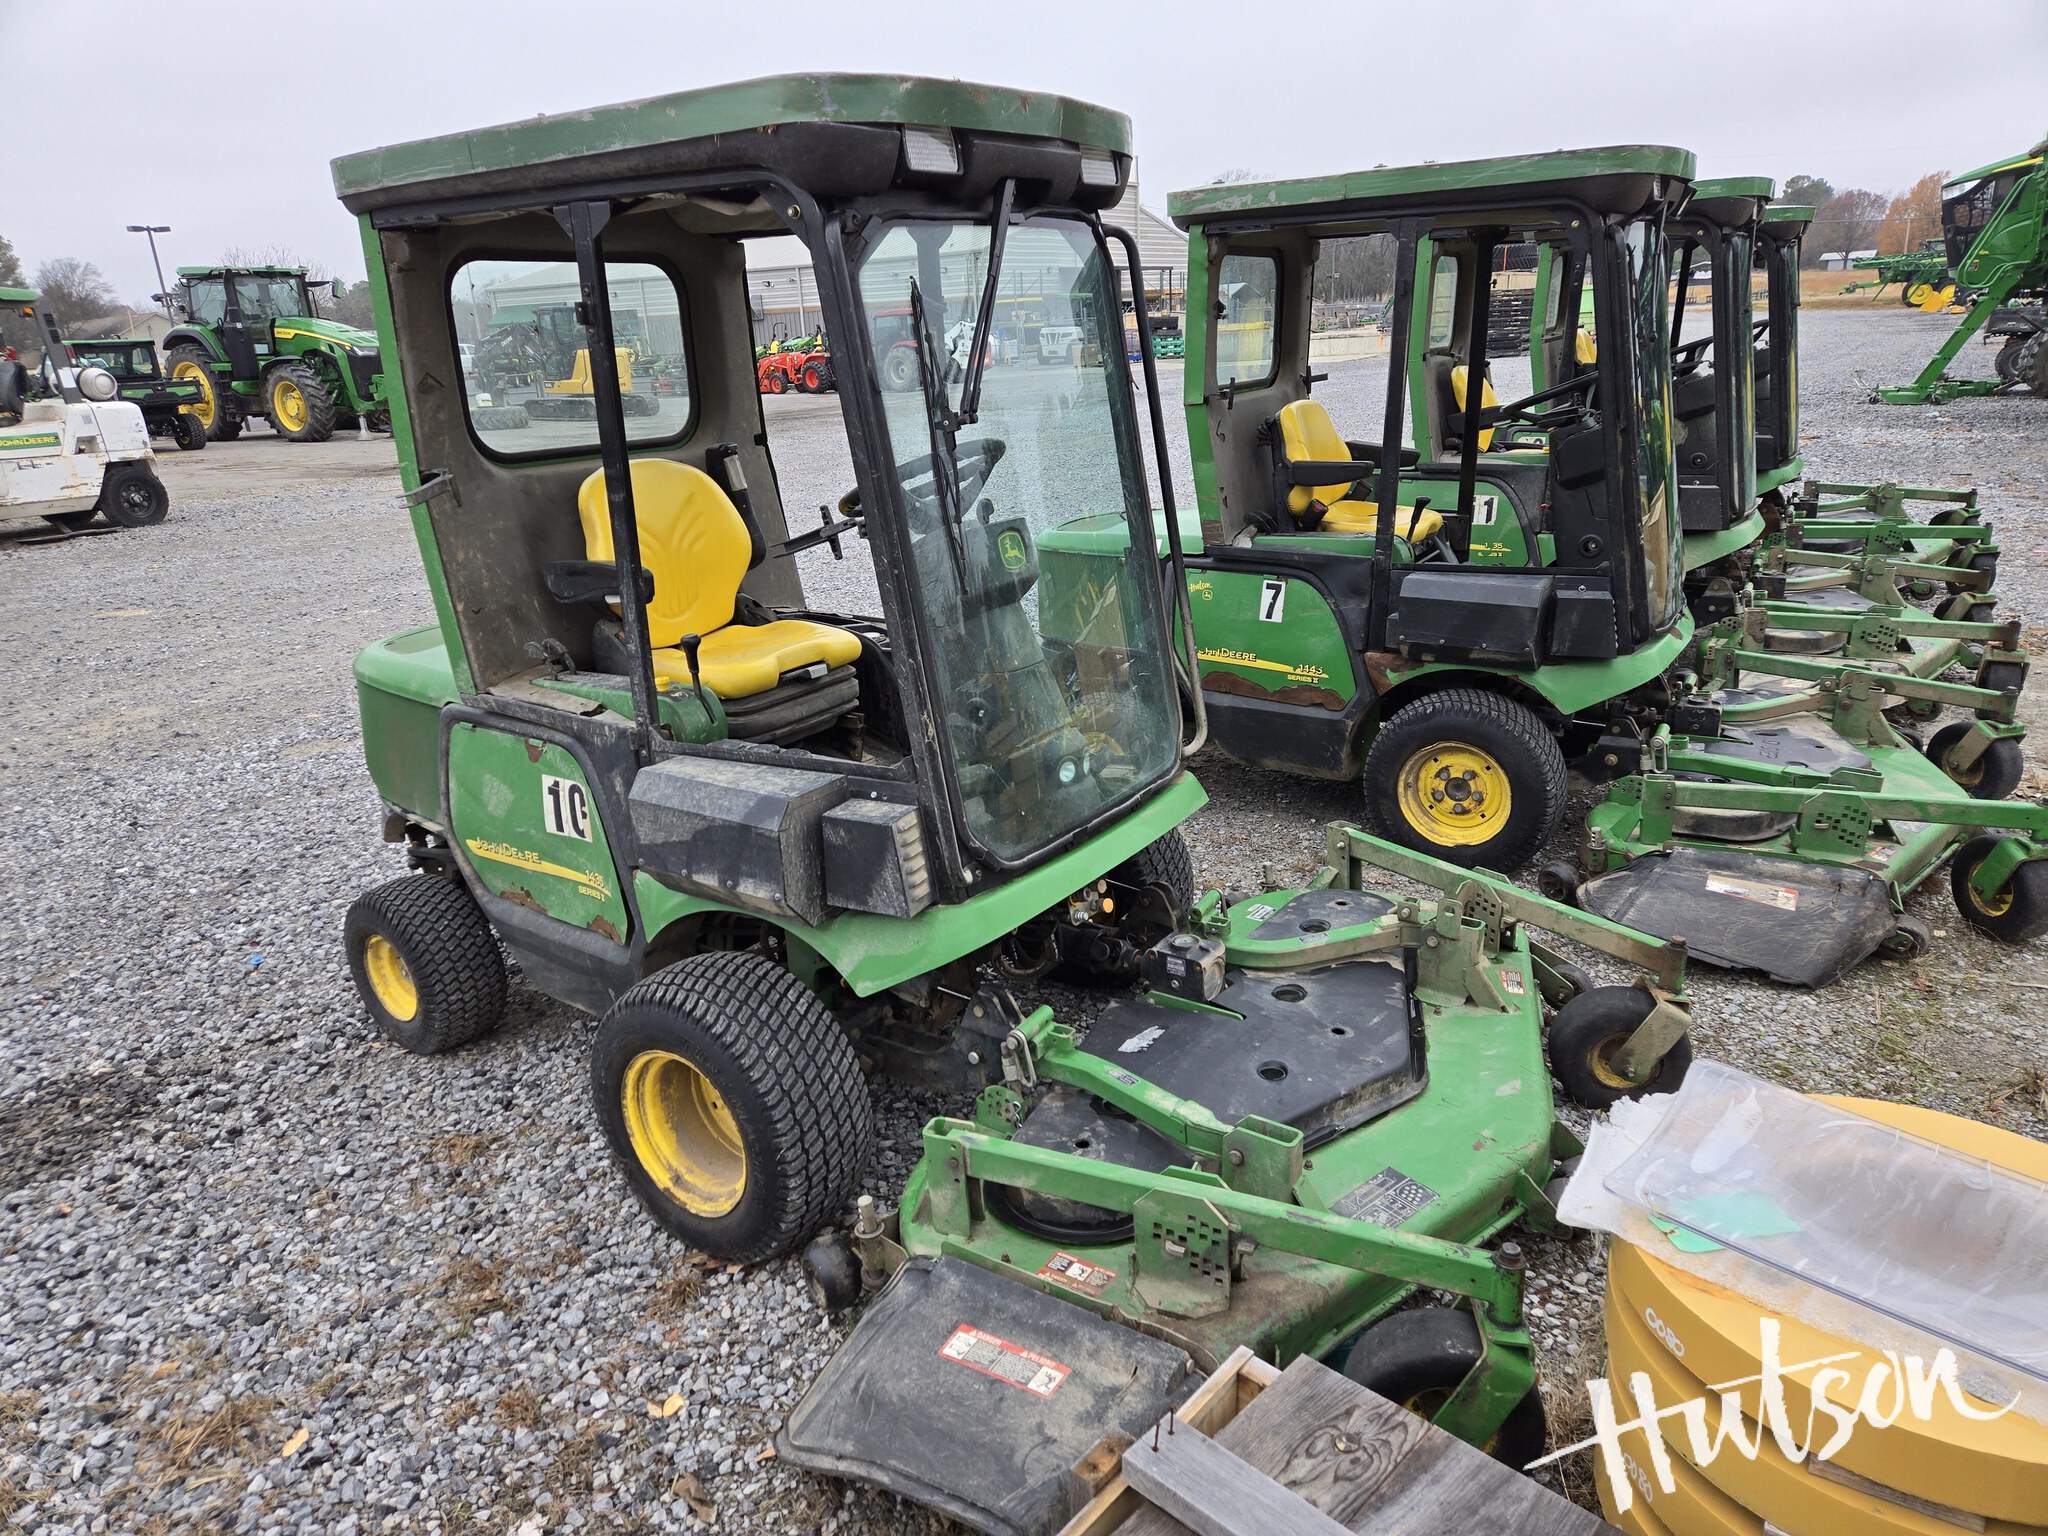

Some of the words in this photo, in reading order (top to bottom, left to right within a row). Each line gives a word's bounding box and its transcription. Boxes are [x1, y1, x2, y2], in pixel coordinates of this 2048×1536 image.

[24, 436, 56, 445] DEERE
[1485, 542, 1504, 550] 135
[1265, 582, 1283, 620] 7
[1221, 647, 1259, 663] DEERE
[976, 1330, 1002, 1346] DANGER
[1027, 1351, 1056, 1368] PELIGRO
